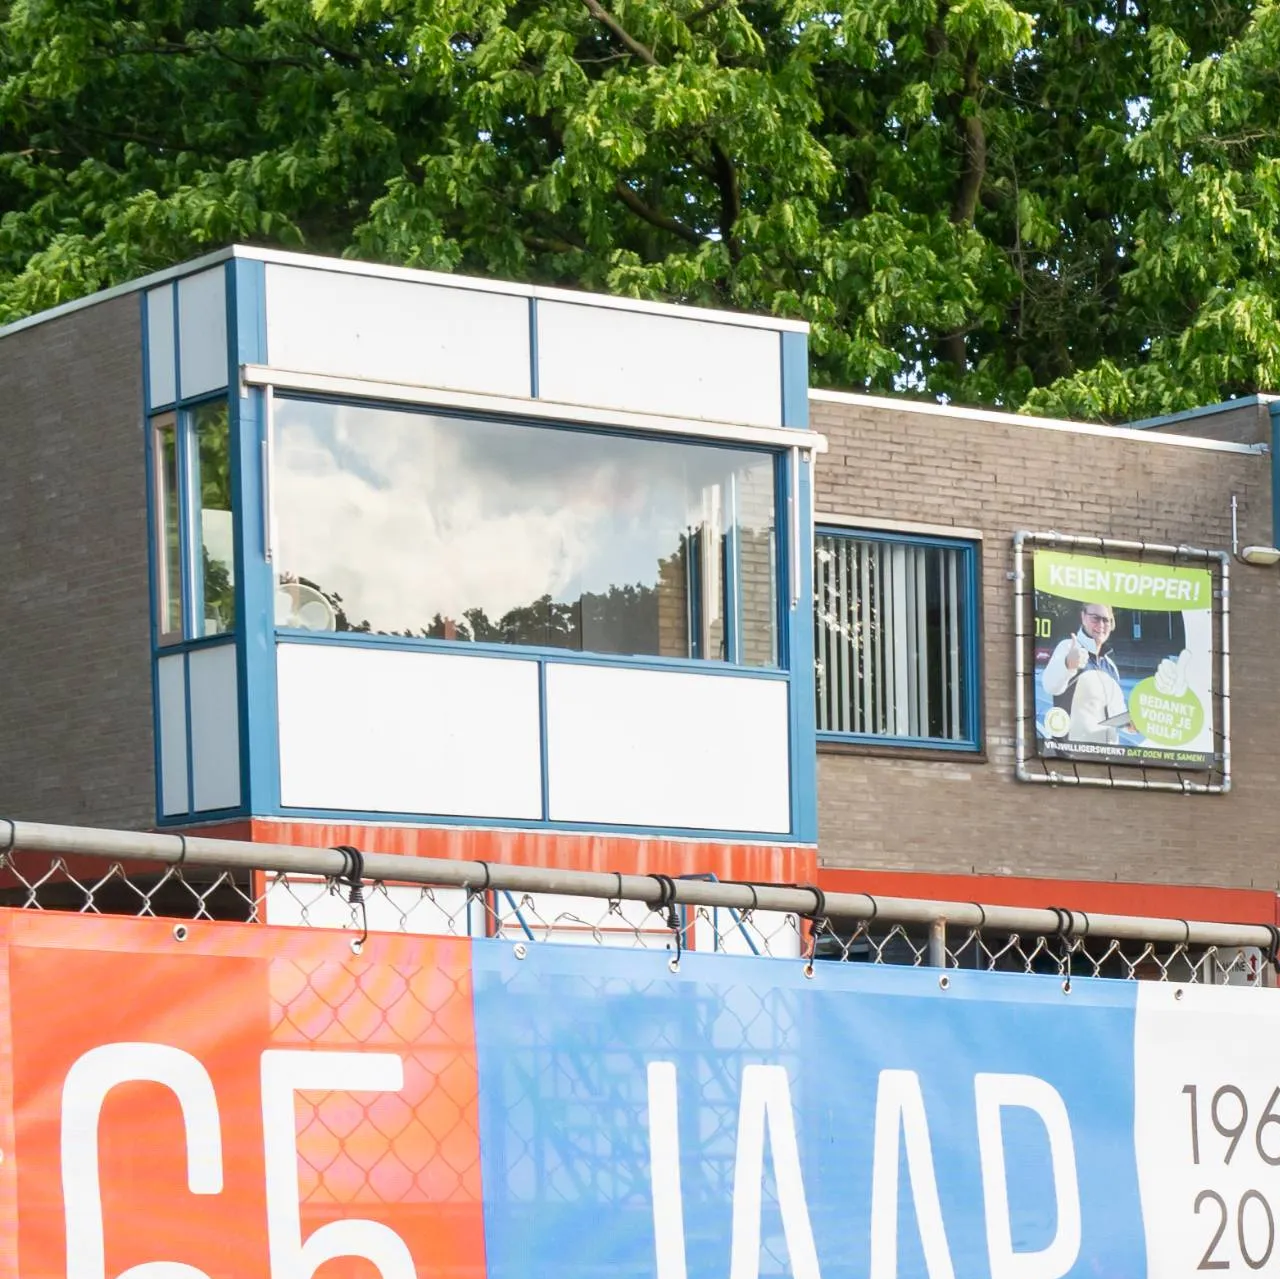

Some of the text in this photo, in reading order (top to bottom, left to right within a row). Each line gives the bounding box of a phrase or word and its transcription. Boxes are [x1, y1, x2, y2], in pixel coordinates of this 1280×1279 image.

[1139, 693, 1196, 717] BEDANKT
[1140, 707, 1192, 730] VOOR JE
[1147, 721, 1182, 741] HULP!
[1127, 749, 1142, 757] DAT
[1143, 751, 1163, 760] DOEN
